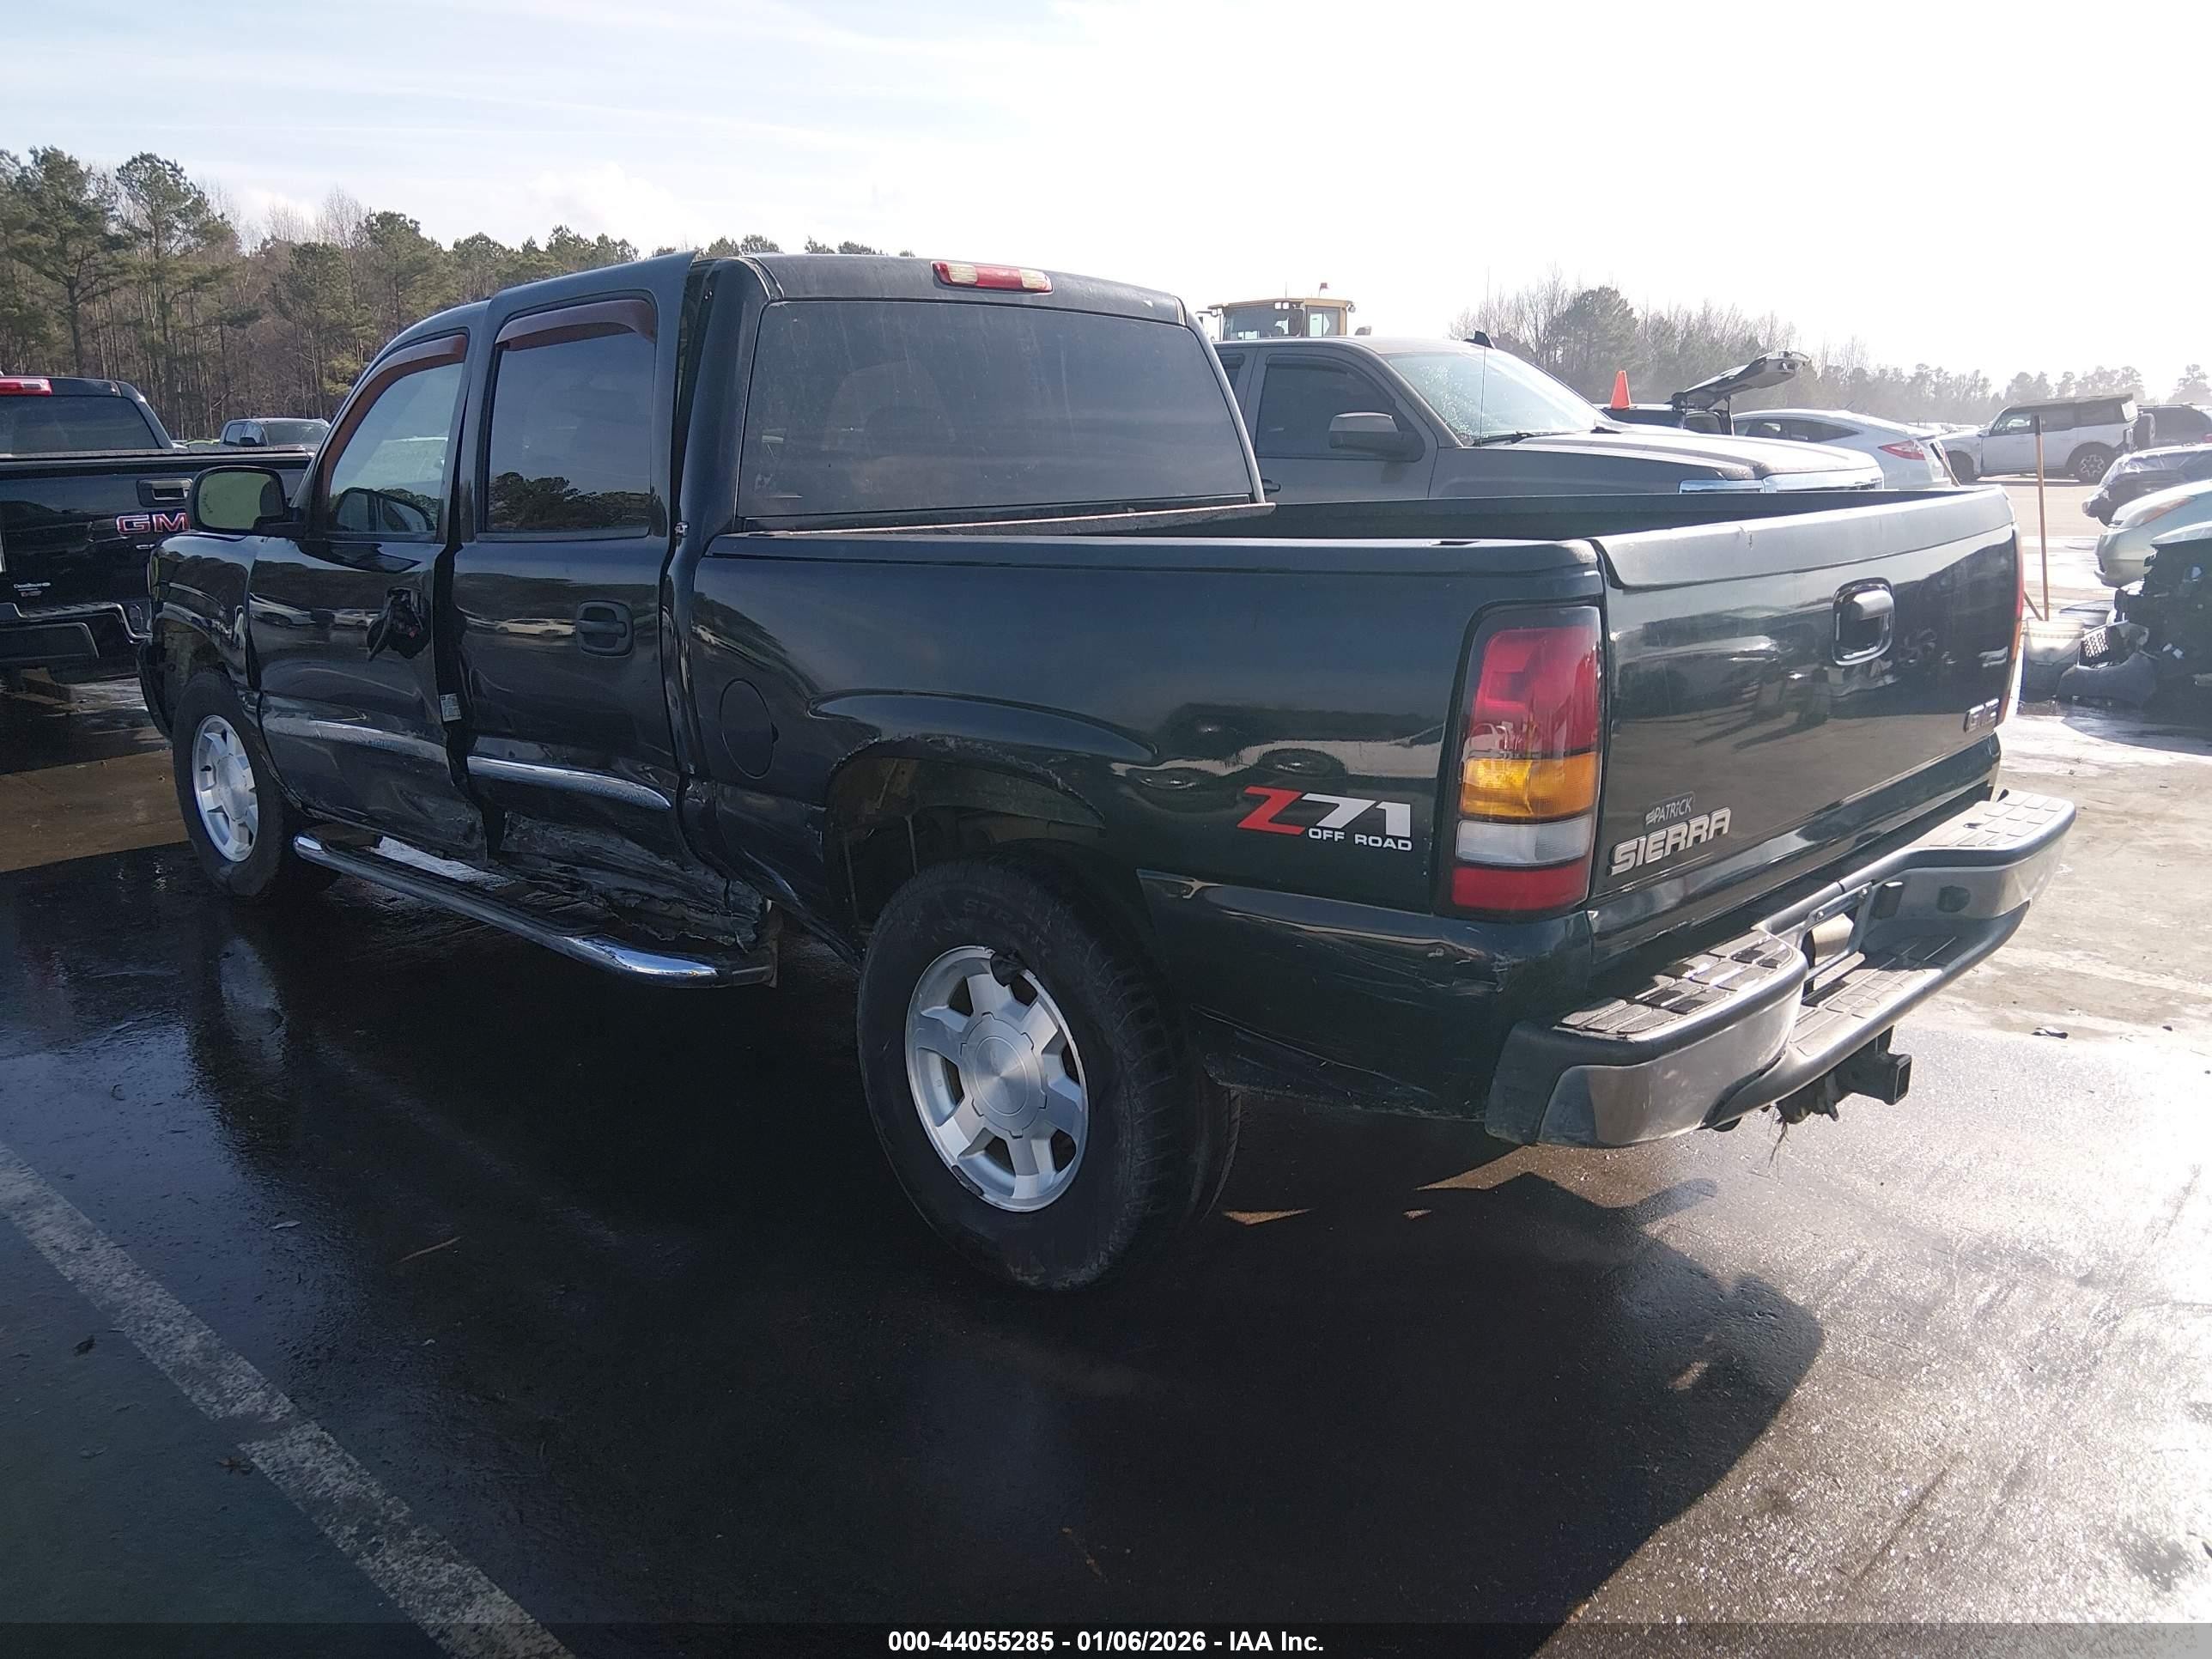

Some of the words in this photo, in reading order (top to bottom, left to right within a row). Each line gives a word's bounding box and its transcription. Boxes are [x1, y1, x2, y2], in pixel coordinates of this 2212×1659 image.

[116, 513, 190, 533] GM
[1237, 786, 1411, 837] Z71
[1308, 828, 1345, 842] OFF
[1354, 833, 1413, 852] ROAD
[1611, 806, 1731, 876] SIERRA
